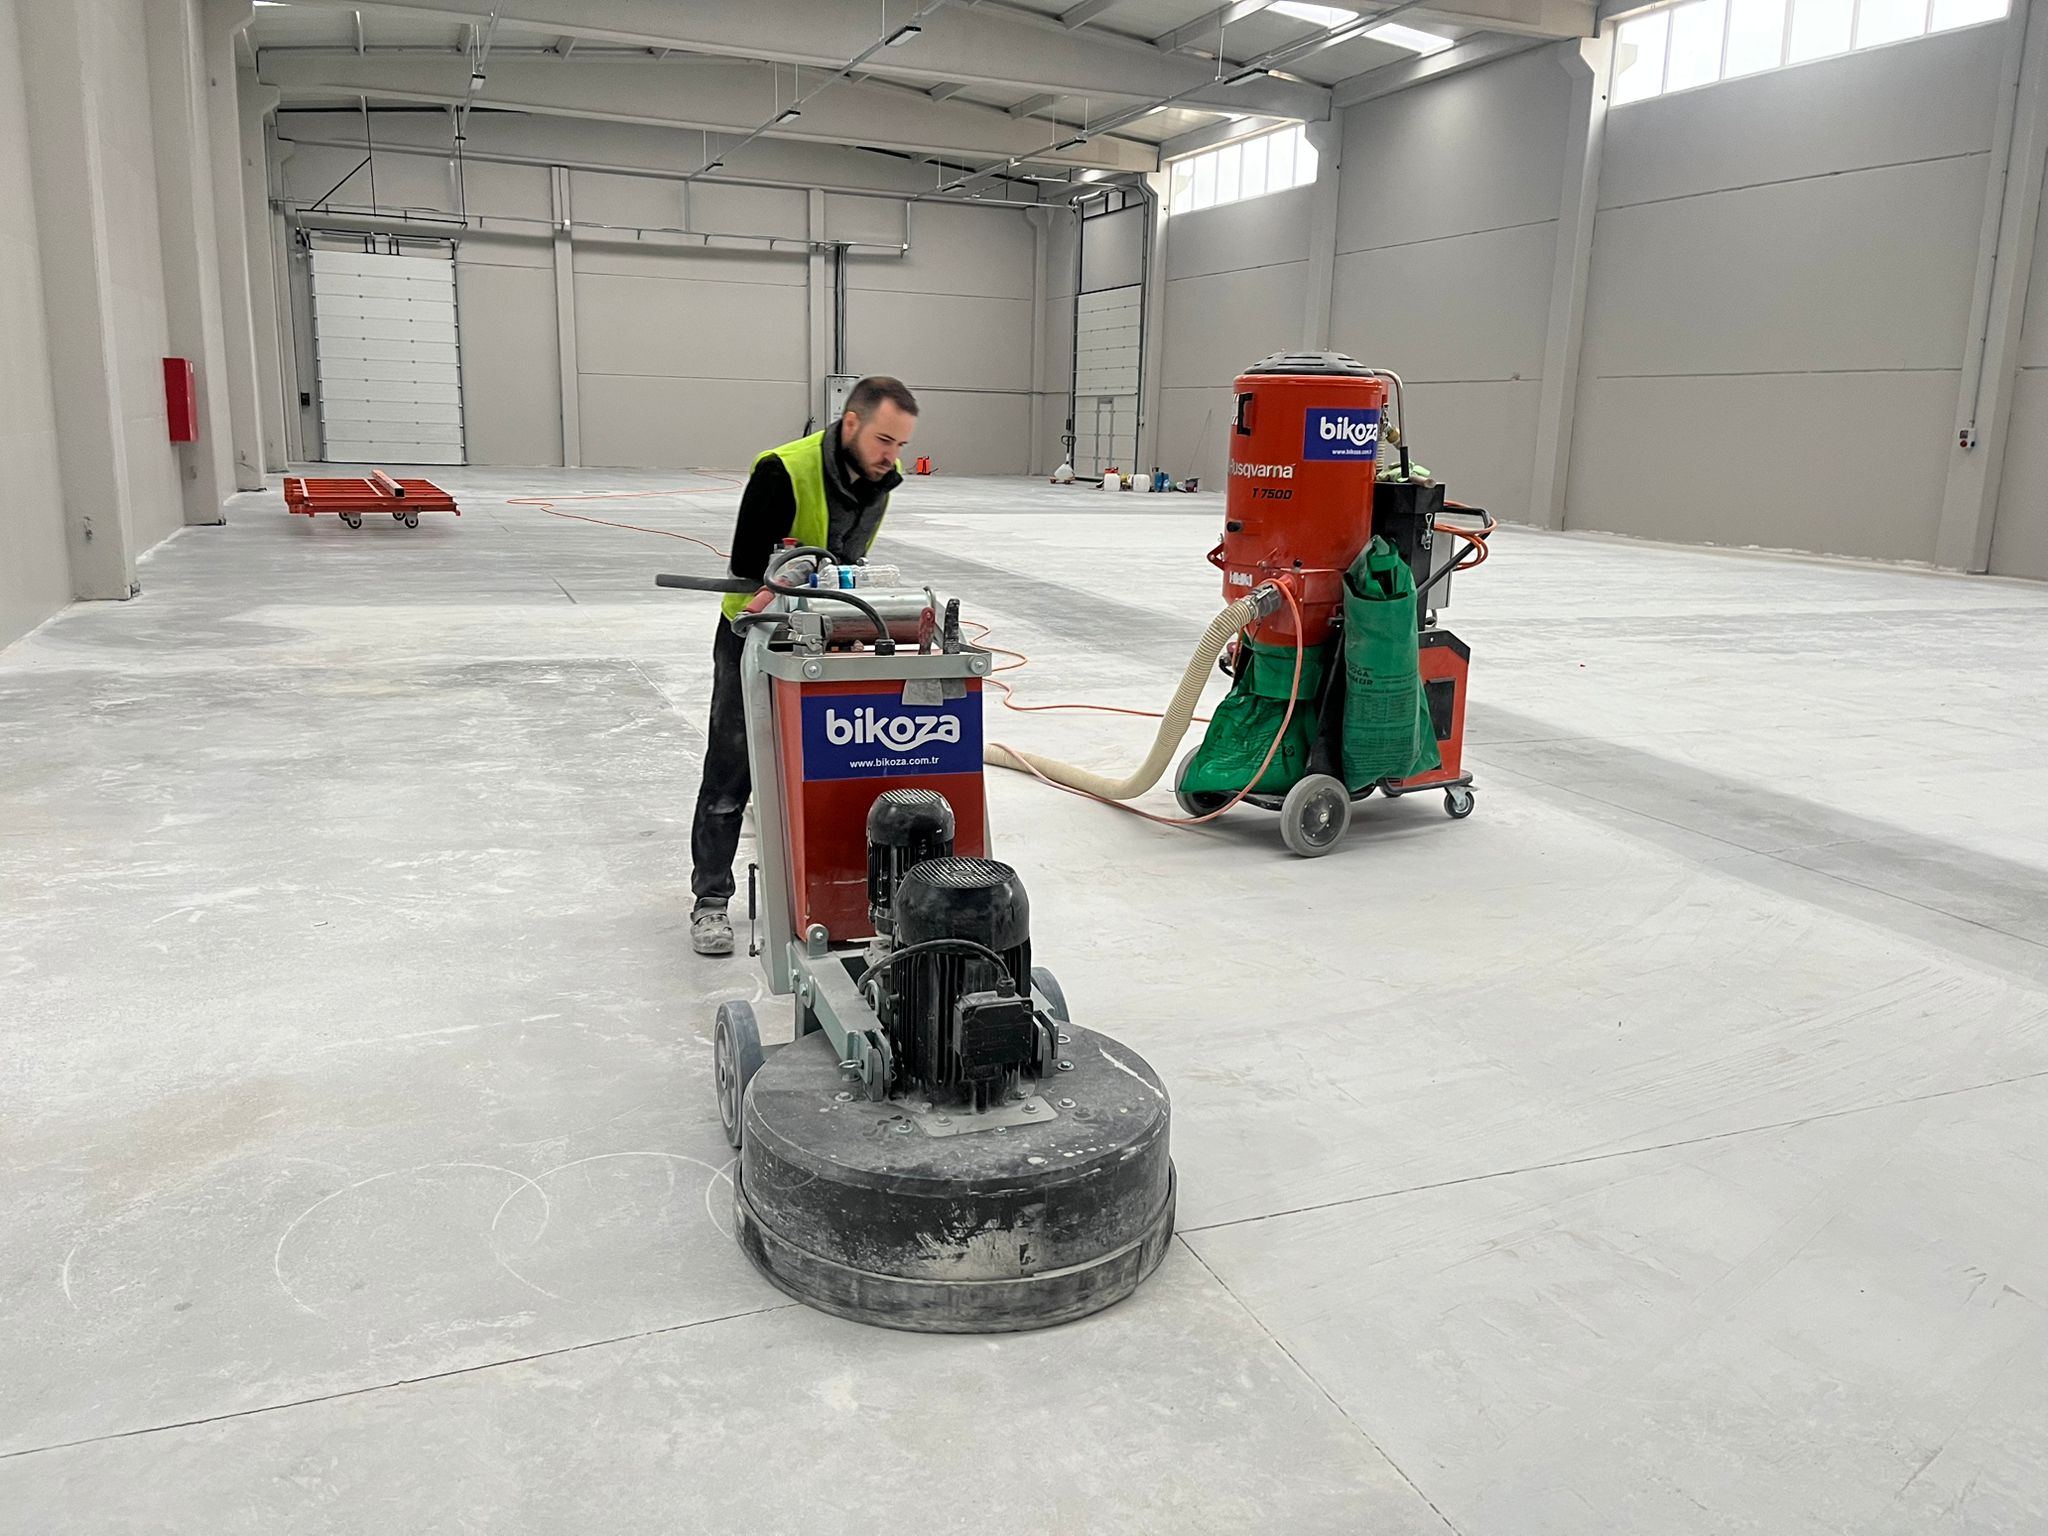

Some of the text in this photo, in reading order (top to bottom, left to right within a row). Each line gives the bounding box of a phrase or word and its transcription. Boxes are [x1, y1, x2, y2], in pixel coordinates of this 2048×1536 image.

[1320, 416, 1378, 447] bikoza
[1261, 488, 1293, 500] 7500
[826, 707, 961, 751] bikoza
[849, 756, 940, 768] www.bikoza.com.tr
